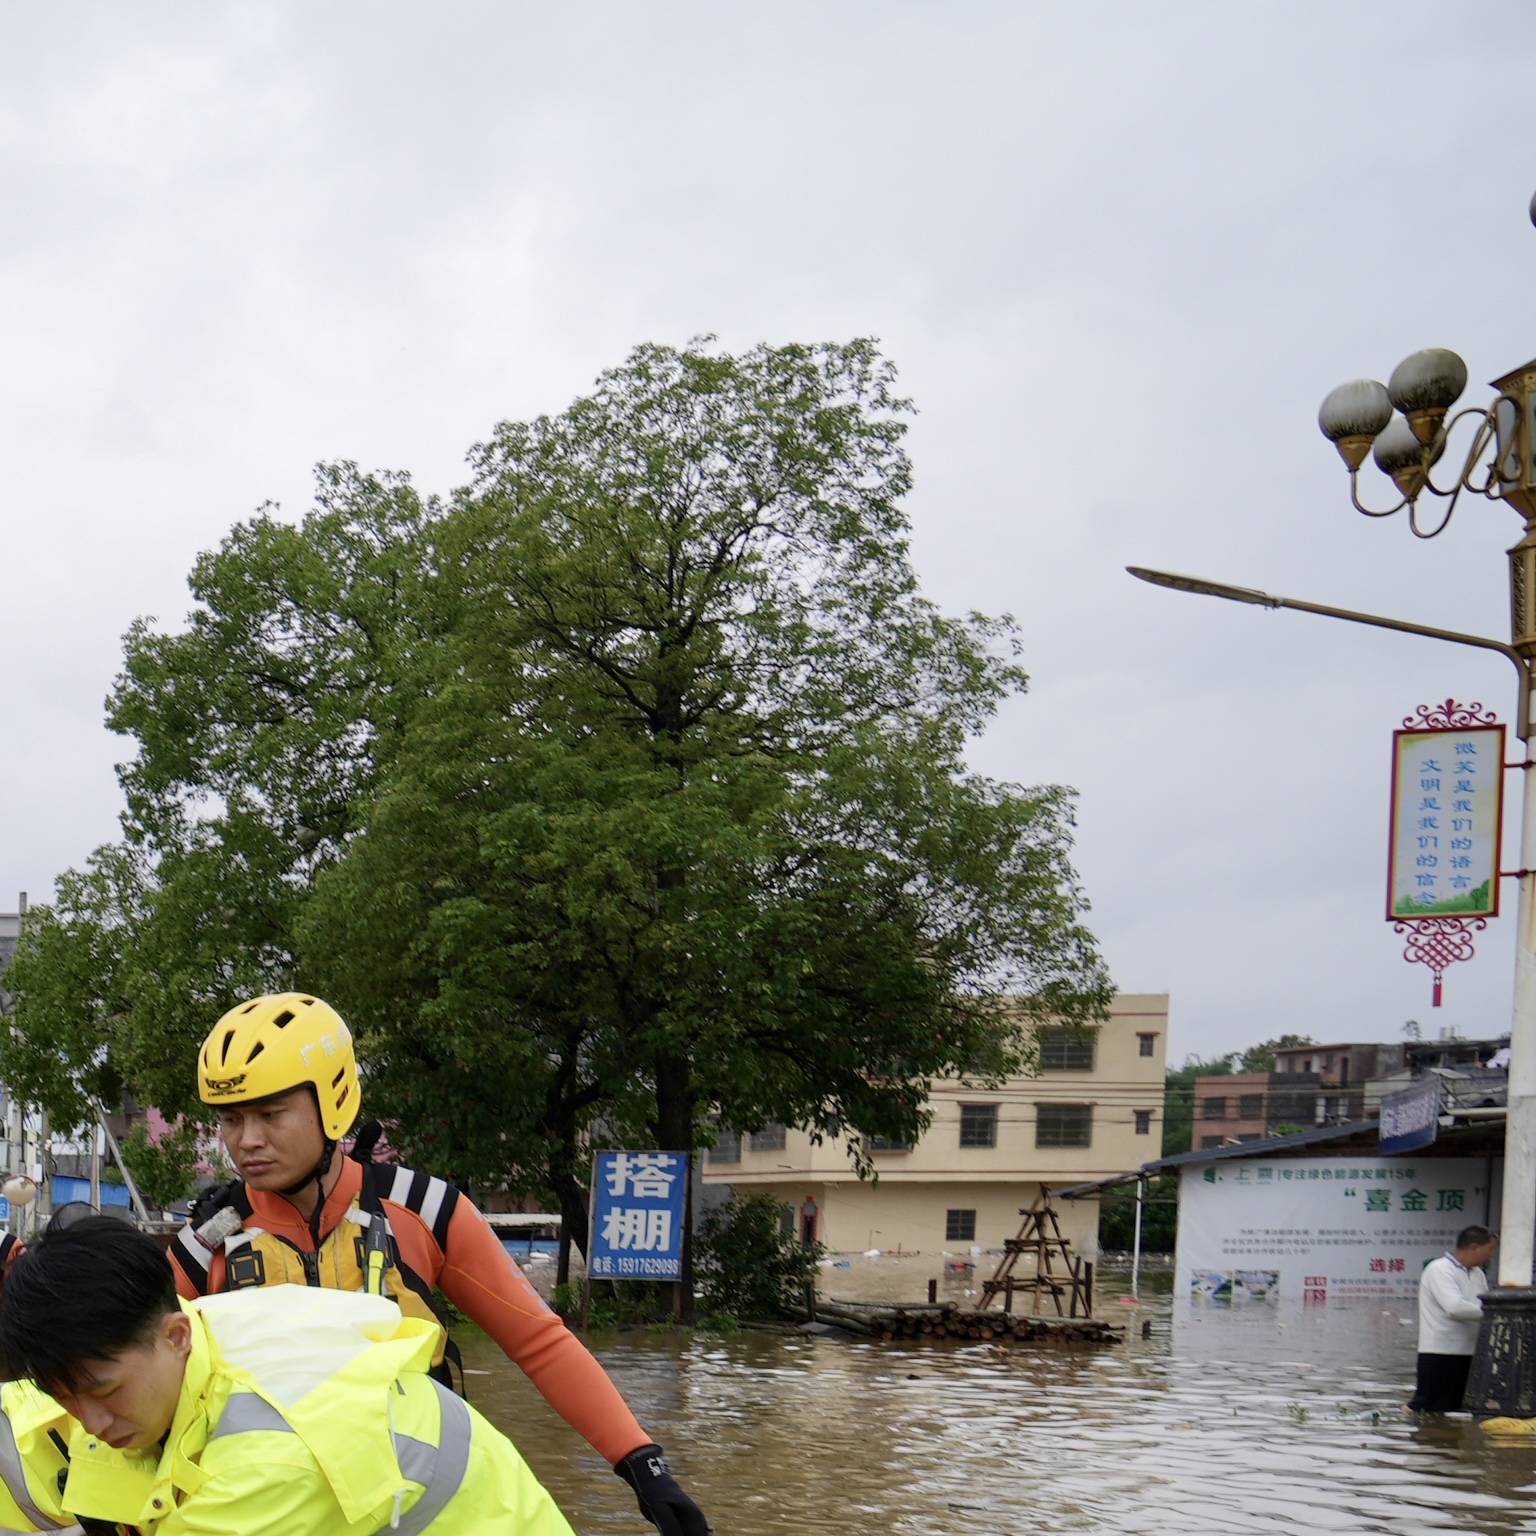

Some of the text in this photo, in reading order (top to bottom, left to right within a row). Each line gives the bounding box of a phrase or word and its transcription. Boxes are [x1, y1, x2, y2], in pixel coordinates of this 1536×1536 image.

[1448, 741, 1478, 889] 微笑是我们的语言
[601, 1153, 677, 1252] 搭棚
